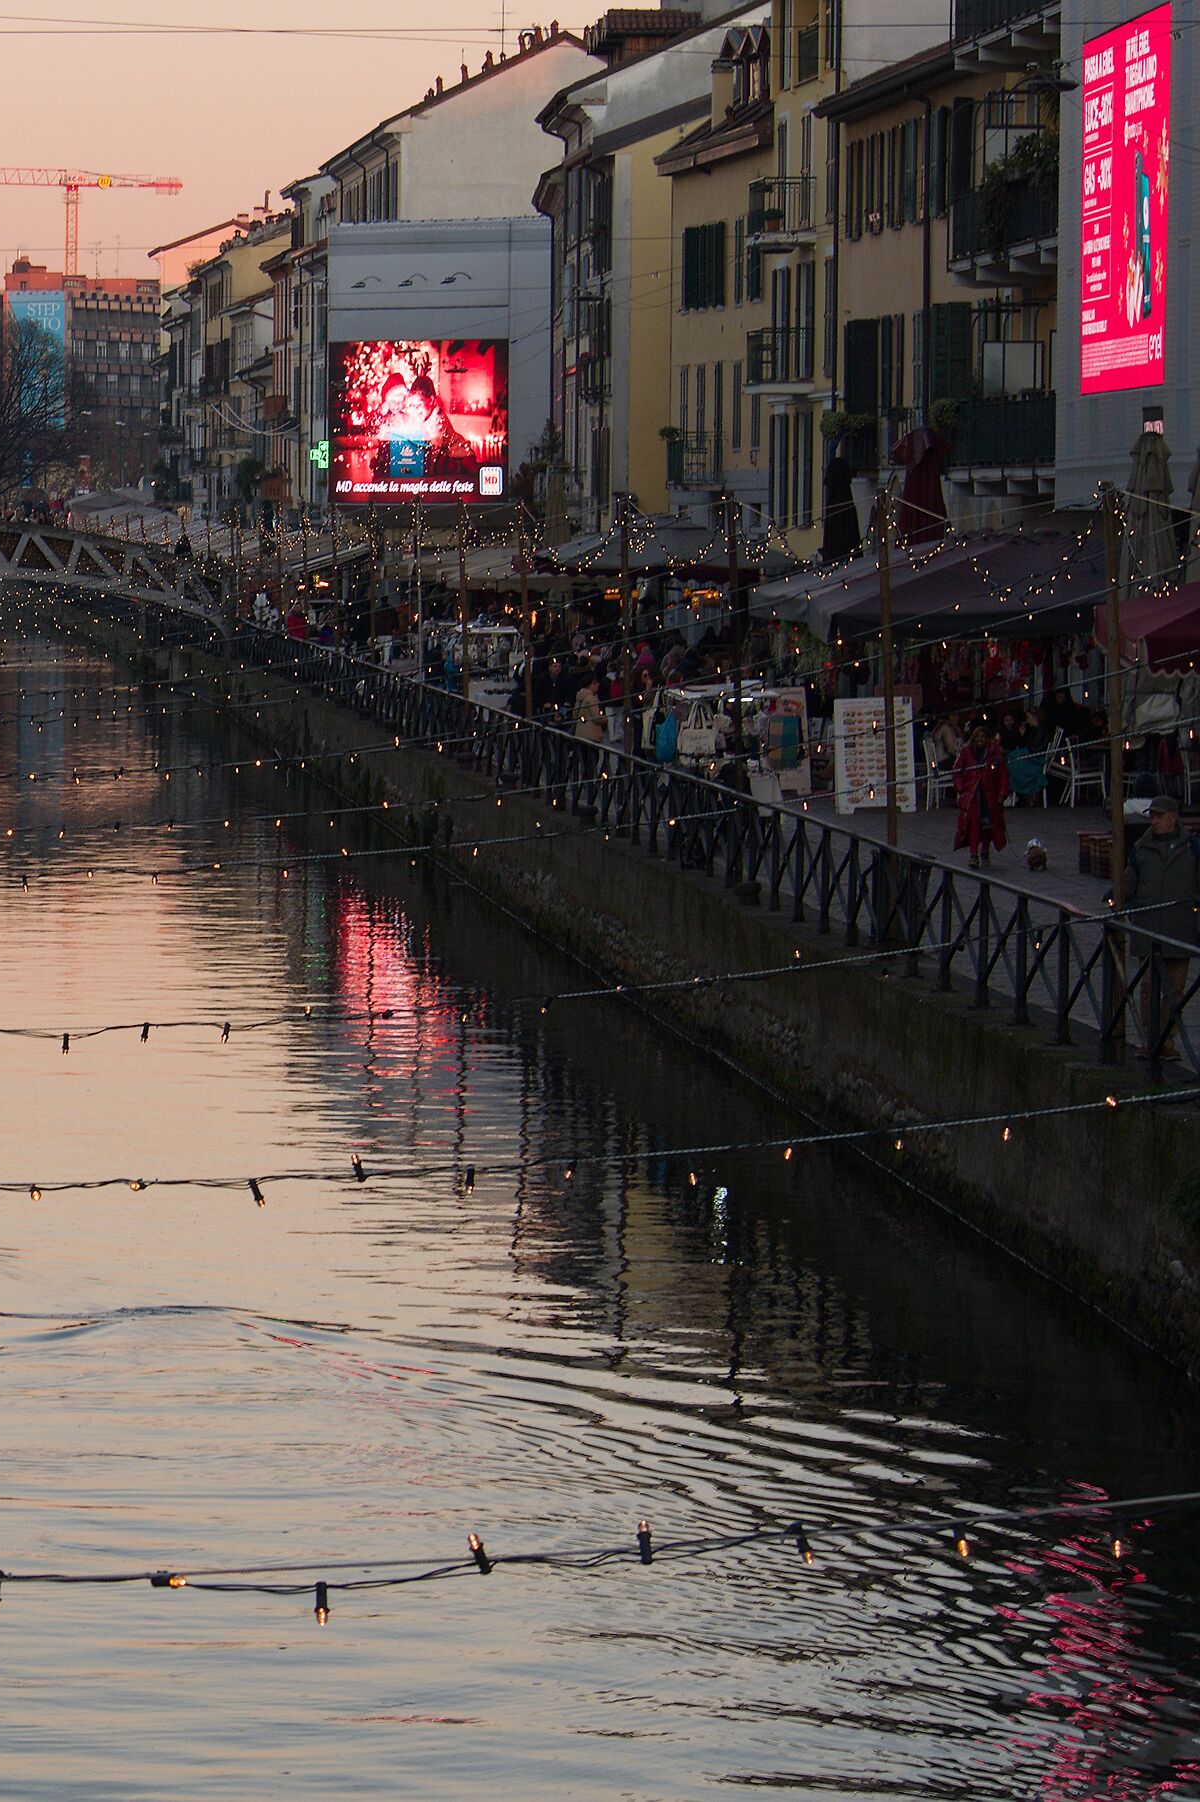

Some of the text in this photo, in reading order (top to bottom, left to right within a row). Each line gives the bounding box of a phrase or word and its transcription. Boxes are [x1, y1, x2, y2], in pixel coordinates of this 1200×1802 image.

[1084, 161, 1096, 196] GAS
[27, 302, 61, 316] STEP
[1148, 325, 1163, 361] enel
[336, 480, 353, 493] MD
[352, 480, 389, 493] accende
[389, 480, 400, 493] la
[430, 480, 451, 493] delle
[452, 480, 474, 494] feste
[484, 476, 498, 485] MD
